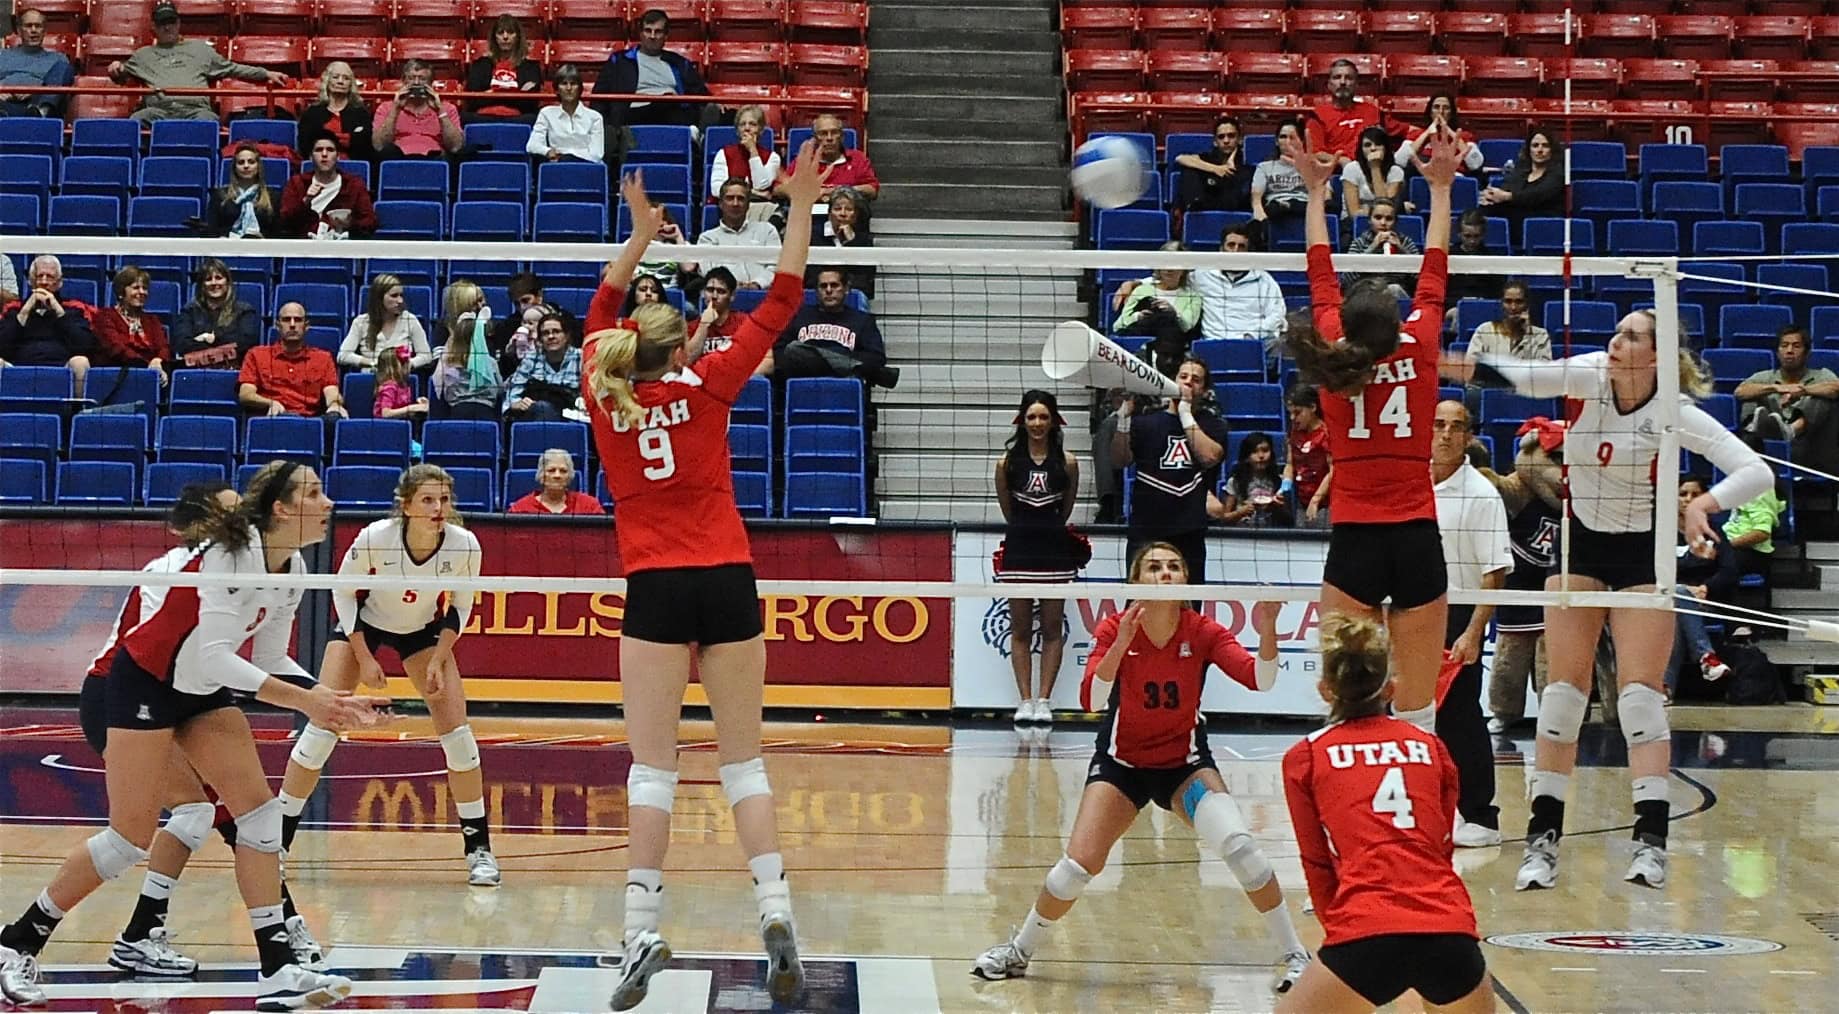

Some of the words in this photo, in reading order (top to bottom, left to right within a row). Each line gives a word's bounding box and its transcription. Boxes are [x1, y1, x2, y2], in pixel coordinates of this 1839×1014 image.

[1664, 125, 1692, 145] 10
[798, 323, 857, 350] ARIZONA
[1348, 385, 1412, 439] 14
[638, 428, 675, 480] 9
[1597, 441, 1613, 467] 9
[402, 589, 417, 603] 5
[758, 595, 929, 643] RGO
[1143, 680, 1180, 710] 33
[1326, 740, 1432, 769] UTAH
[1372, 767, 1416, 829] 4
